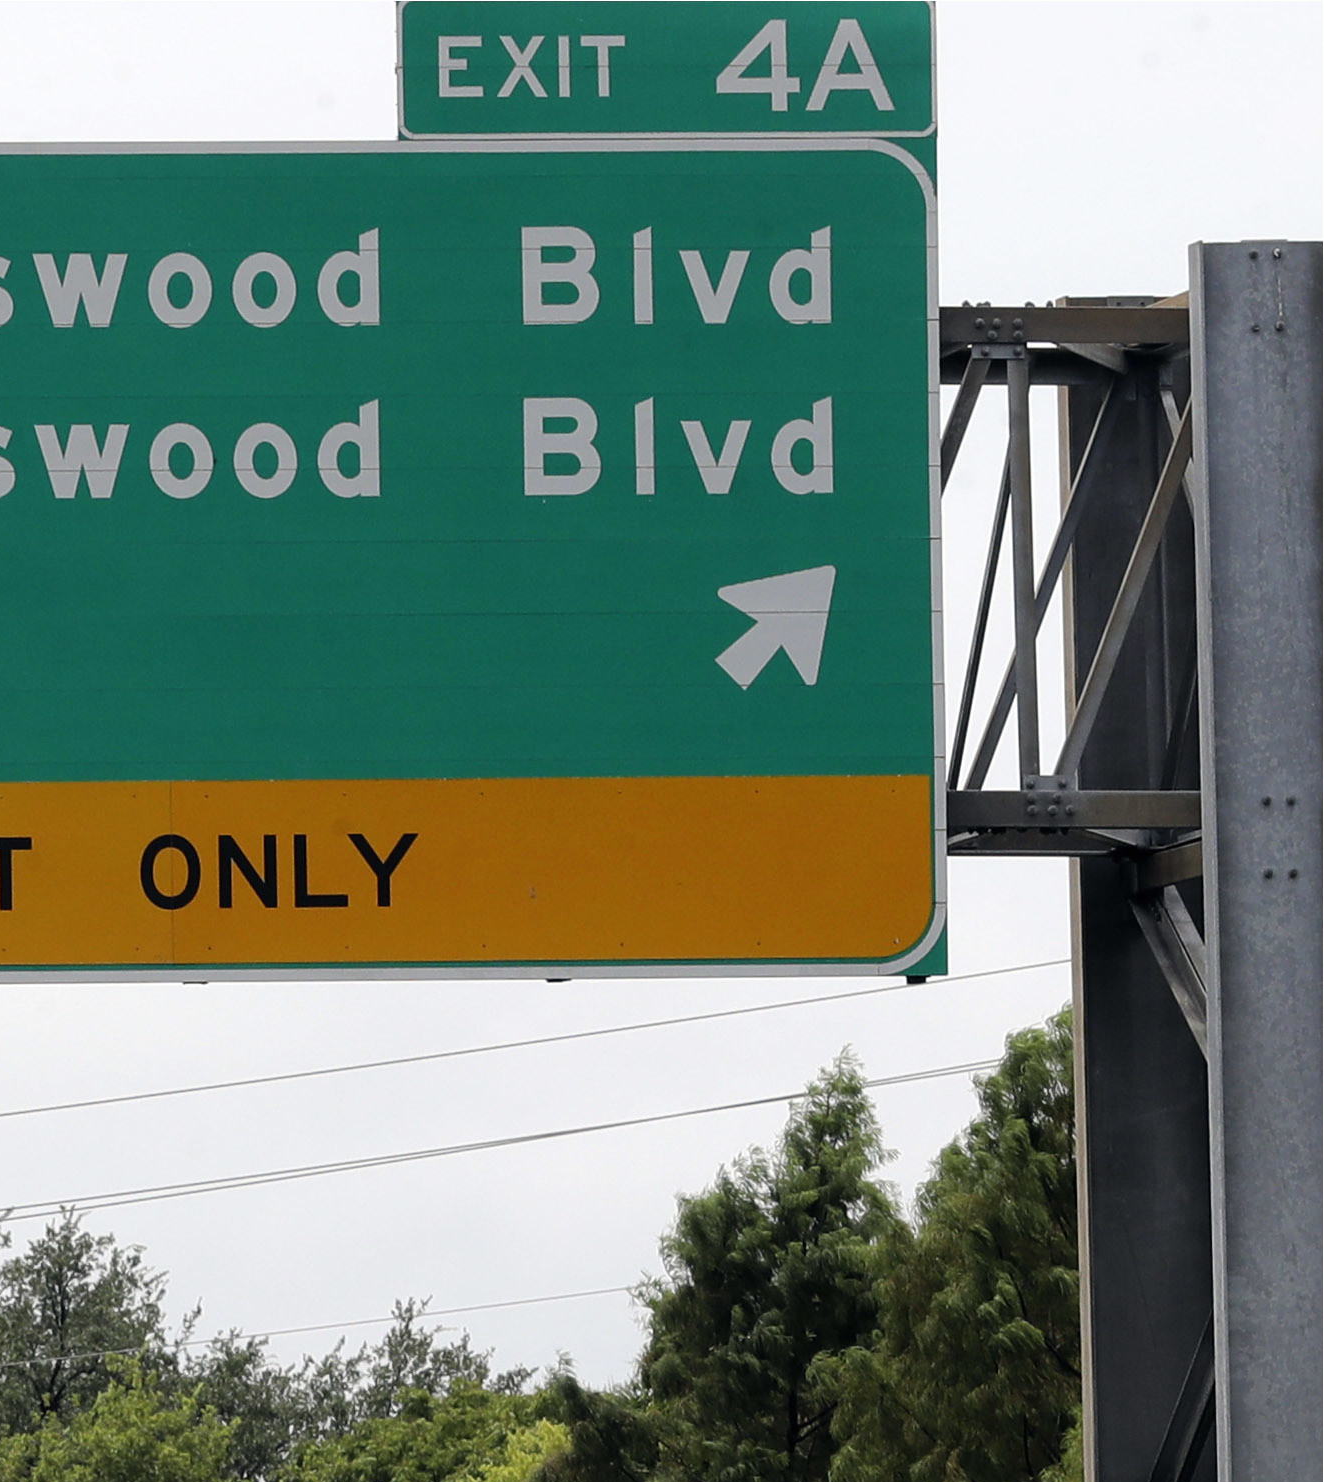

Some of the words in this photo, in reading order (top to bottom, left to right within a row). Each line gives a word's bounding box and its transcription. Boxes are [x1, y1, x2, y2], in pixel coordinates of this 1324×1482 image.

[438, 35, 626, 98] EXIT
[715, 18, 895, 112] 4A
[521, 225, 832, 326] Blvd
[523, 396, 834, 496] Blvd
[139, 832, 419, 911] ONLY
